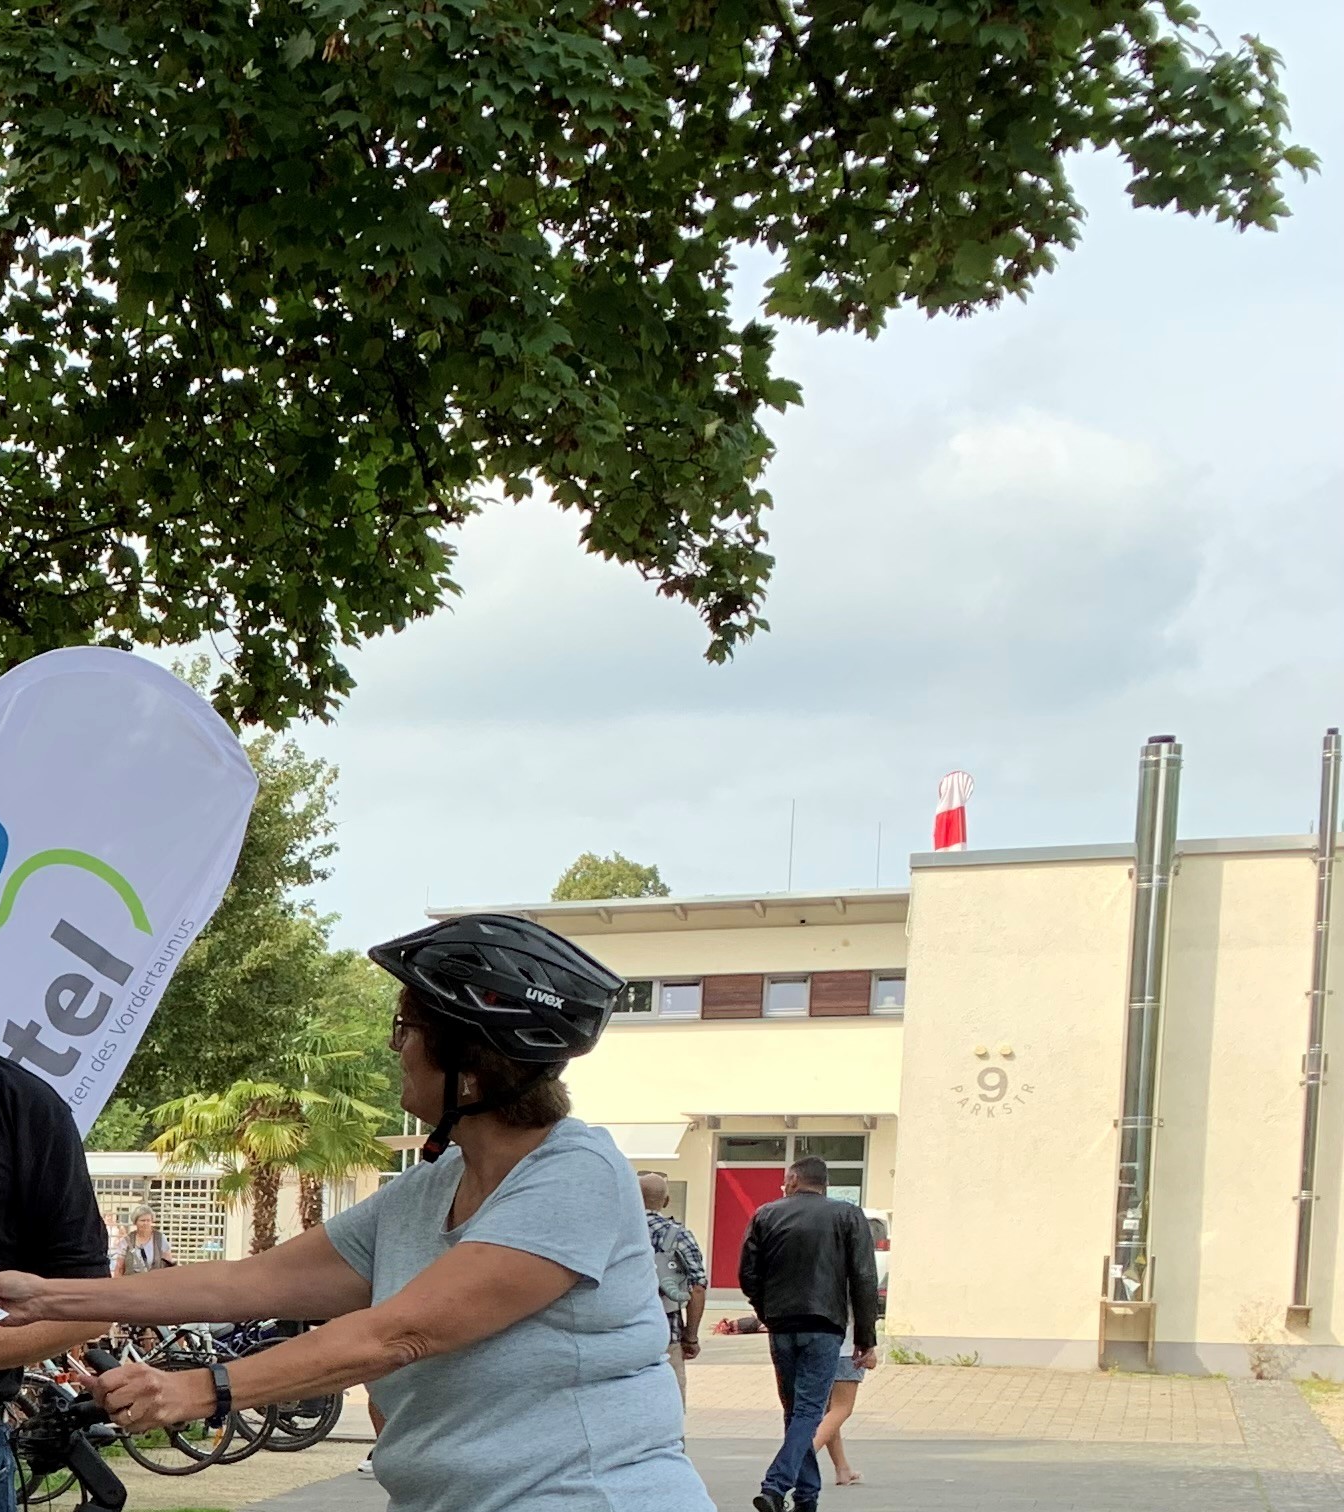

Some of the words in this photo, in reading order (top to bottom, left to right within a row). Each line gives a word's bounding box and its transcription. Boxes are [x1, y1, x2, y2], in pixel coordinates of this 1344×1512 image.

[90, 1040, 118, 1073] des
[109, 918, 195, 1036] Vordertaunus
[525, 987, 565, 1010] uvex
[950, 1083, 1036, 1118] PARKSTR
[976, 1066, 1009, 1103] 9
